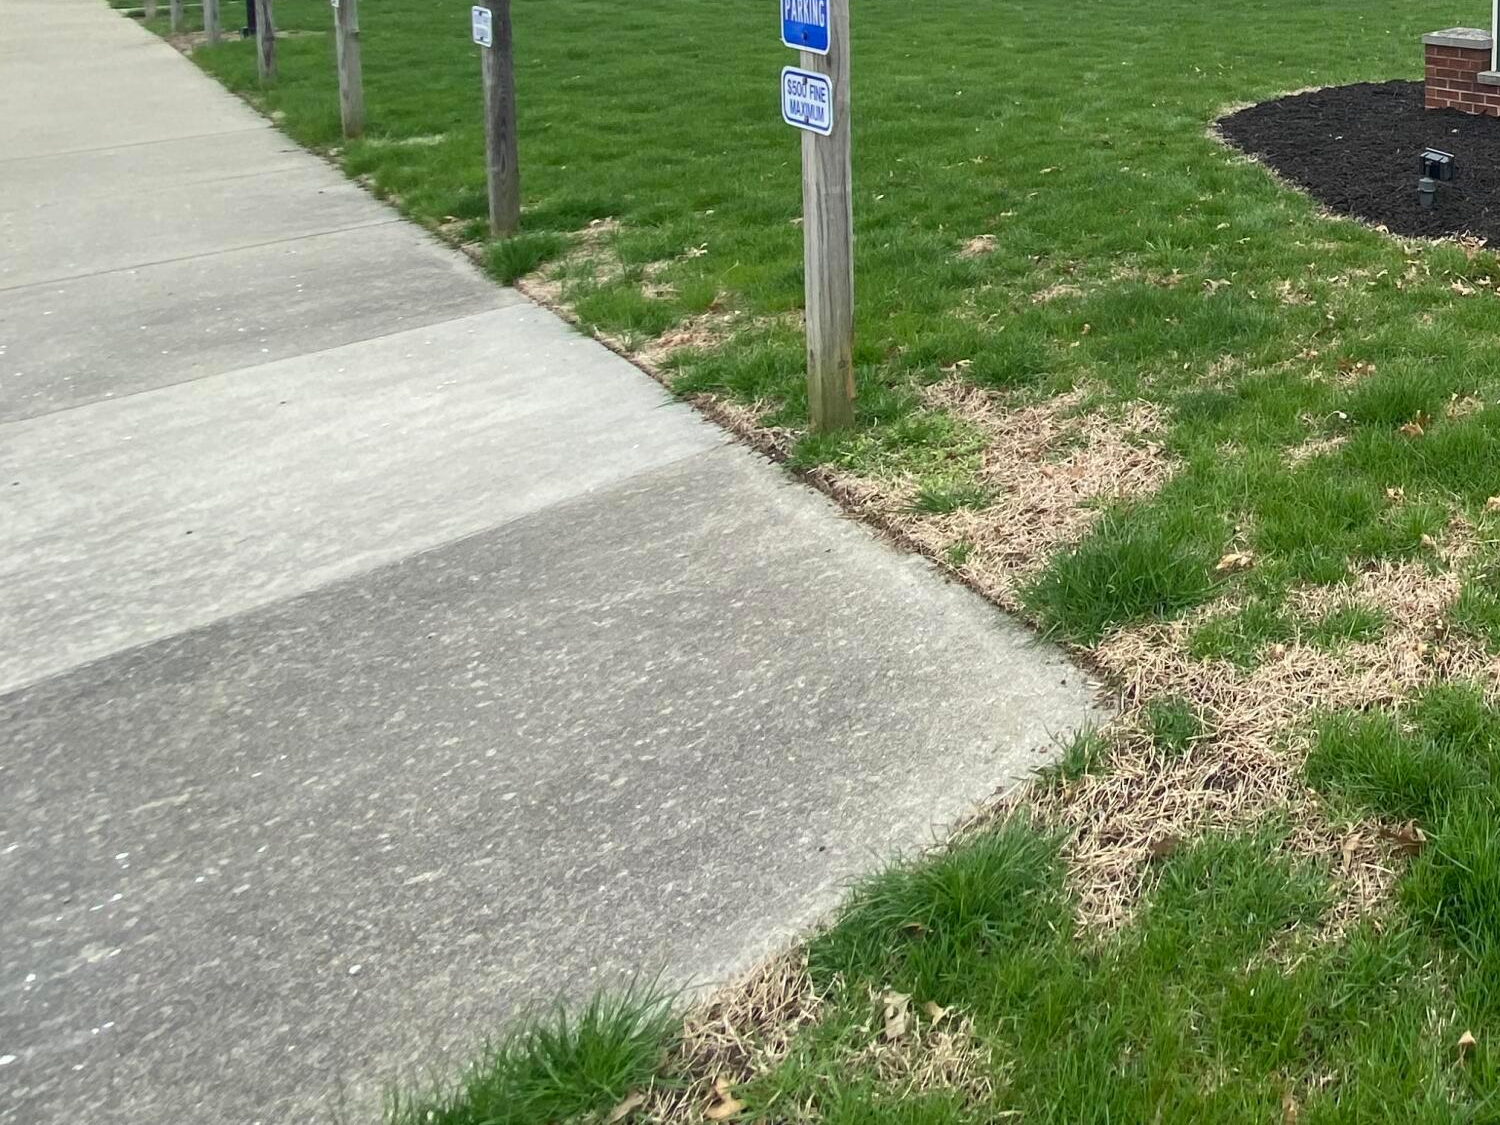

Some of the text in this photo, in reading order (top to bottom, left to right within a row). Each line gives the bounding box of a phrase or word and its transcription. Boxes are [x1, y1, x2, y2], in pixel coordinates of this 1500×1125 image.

[787, 78, 826, 104] $500 FINE
[789, 98, 825, 123] MAXIMUM
